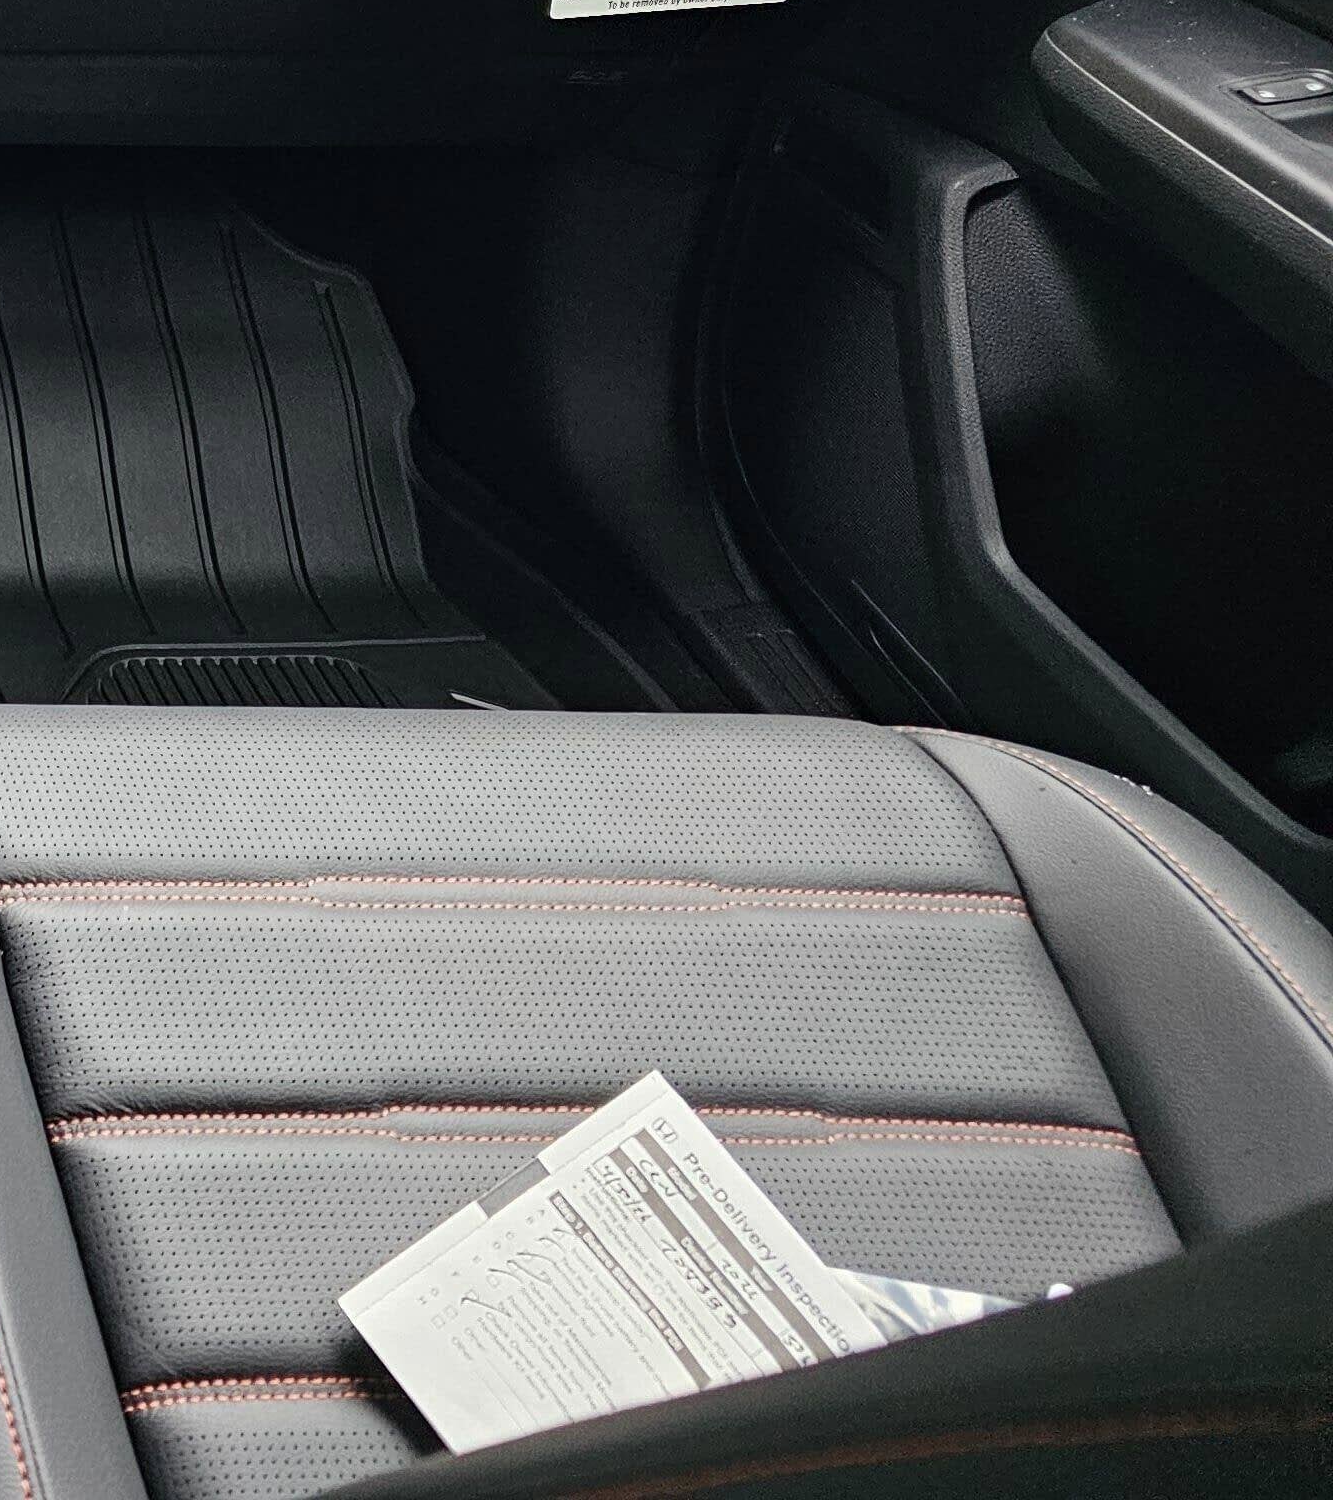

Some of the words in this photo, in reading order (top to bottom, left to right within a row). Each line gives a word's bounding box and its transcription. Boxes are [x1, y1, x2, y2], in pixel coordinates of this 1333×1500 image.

[608, 1, 618, 10] To
[619, 0, 630, 9] be
[681, 1151, 779, 1265] Pre-Delivery
[773, 1262, 855, 1356] Inspectio
